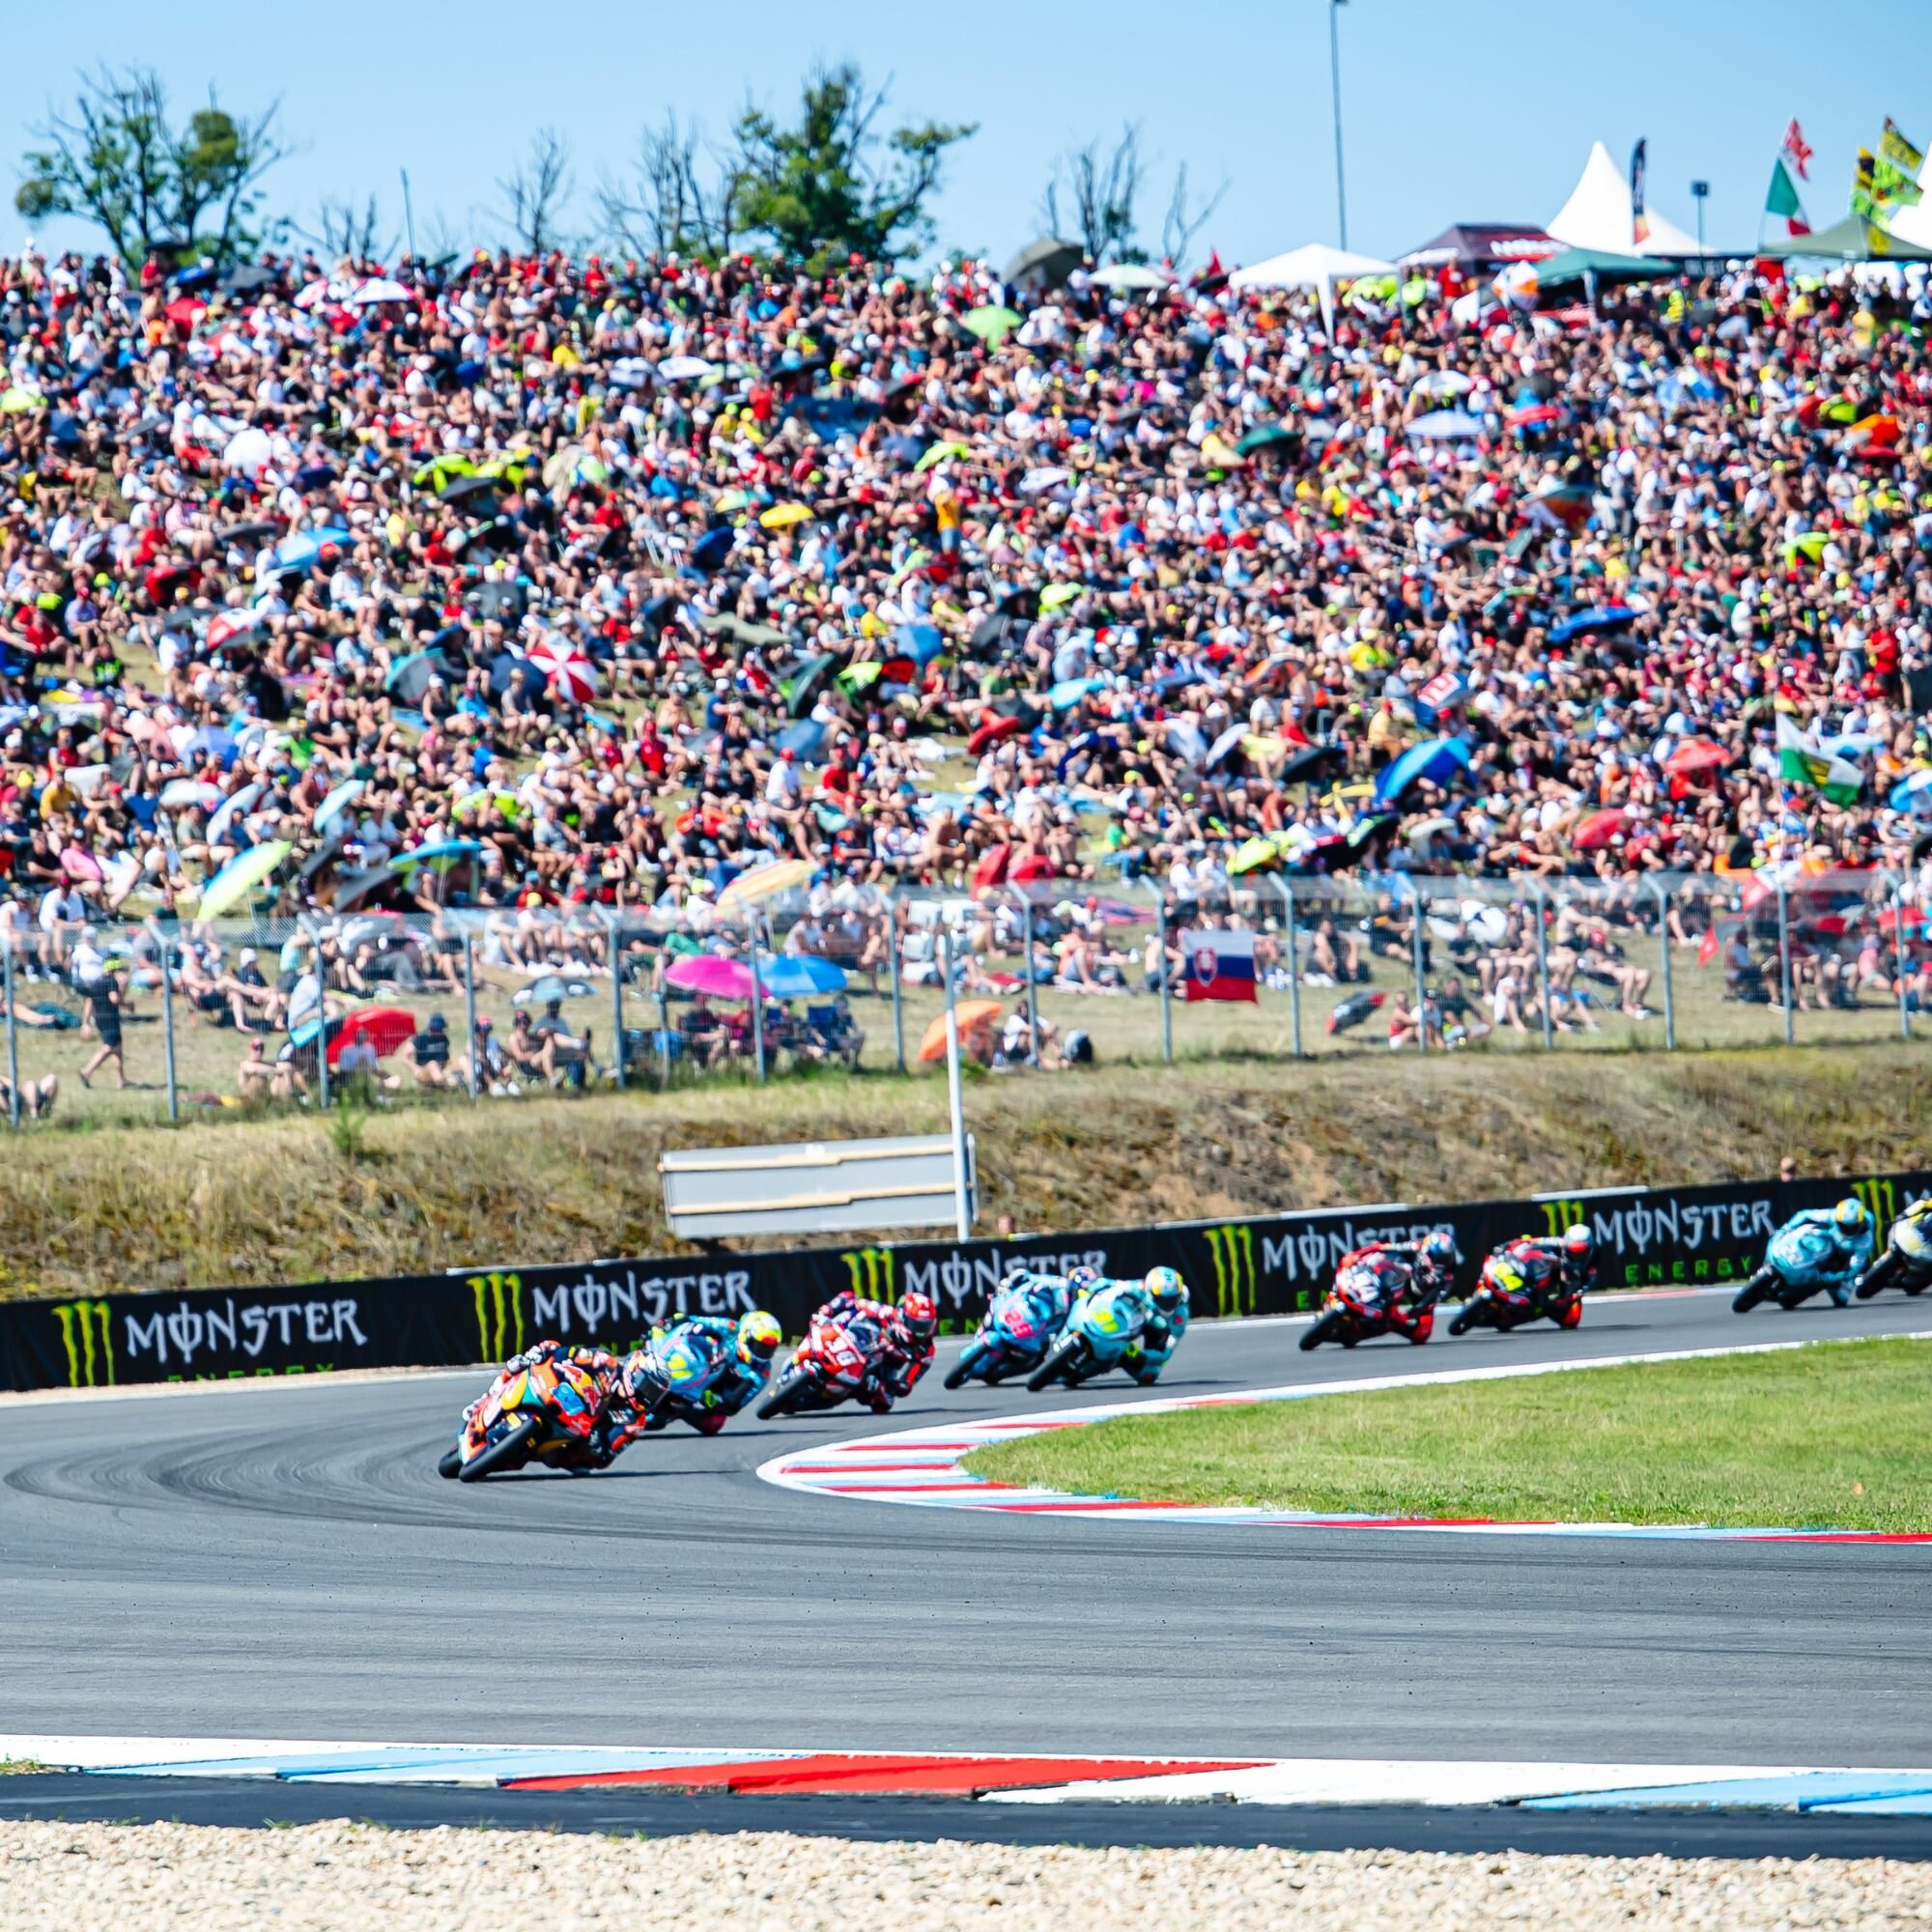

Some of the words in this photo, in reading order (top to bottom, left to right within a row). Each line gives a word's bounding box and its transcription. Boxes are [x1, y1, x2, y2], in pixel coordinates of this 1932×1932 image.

[1593, 1198, 1775, 1255] MONSTER
[1625, 1256, 1752, 1283] ENERGY
[125, 1297, 368, 1364] MONSTER
[532, 1269, 757, 1335] MONSTER
